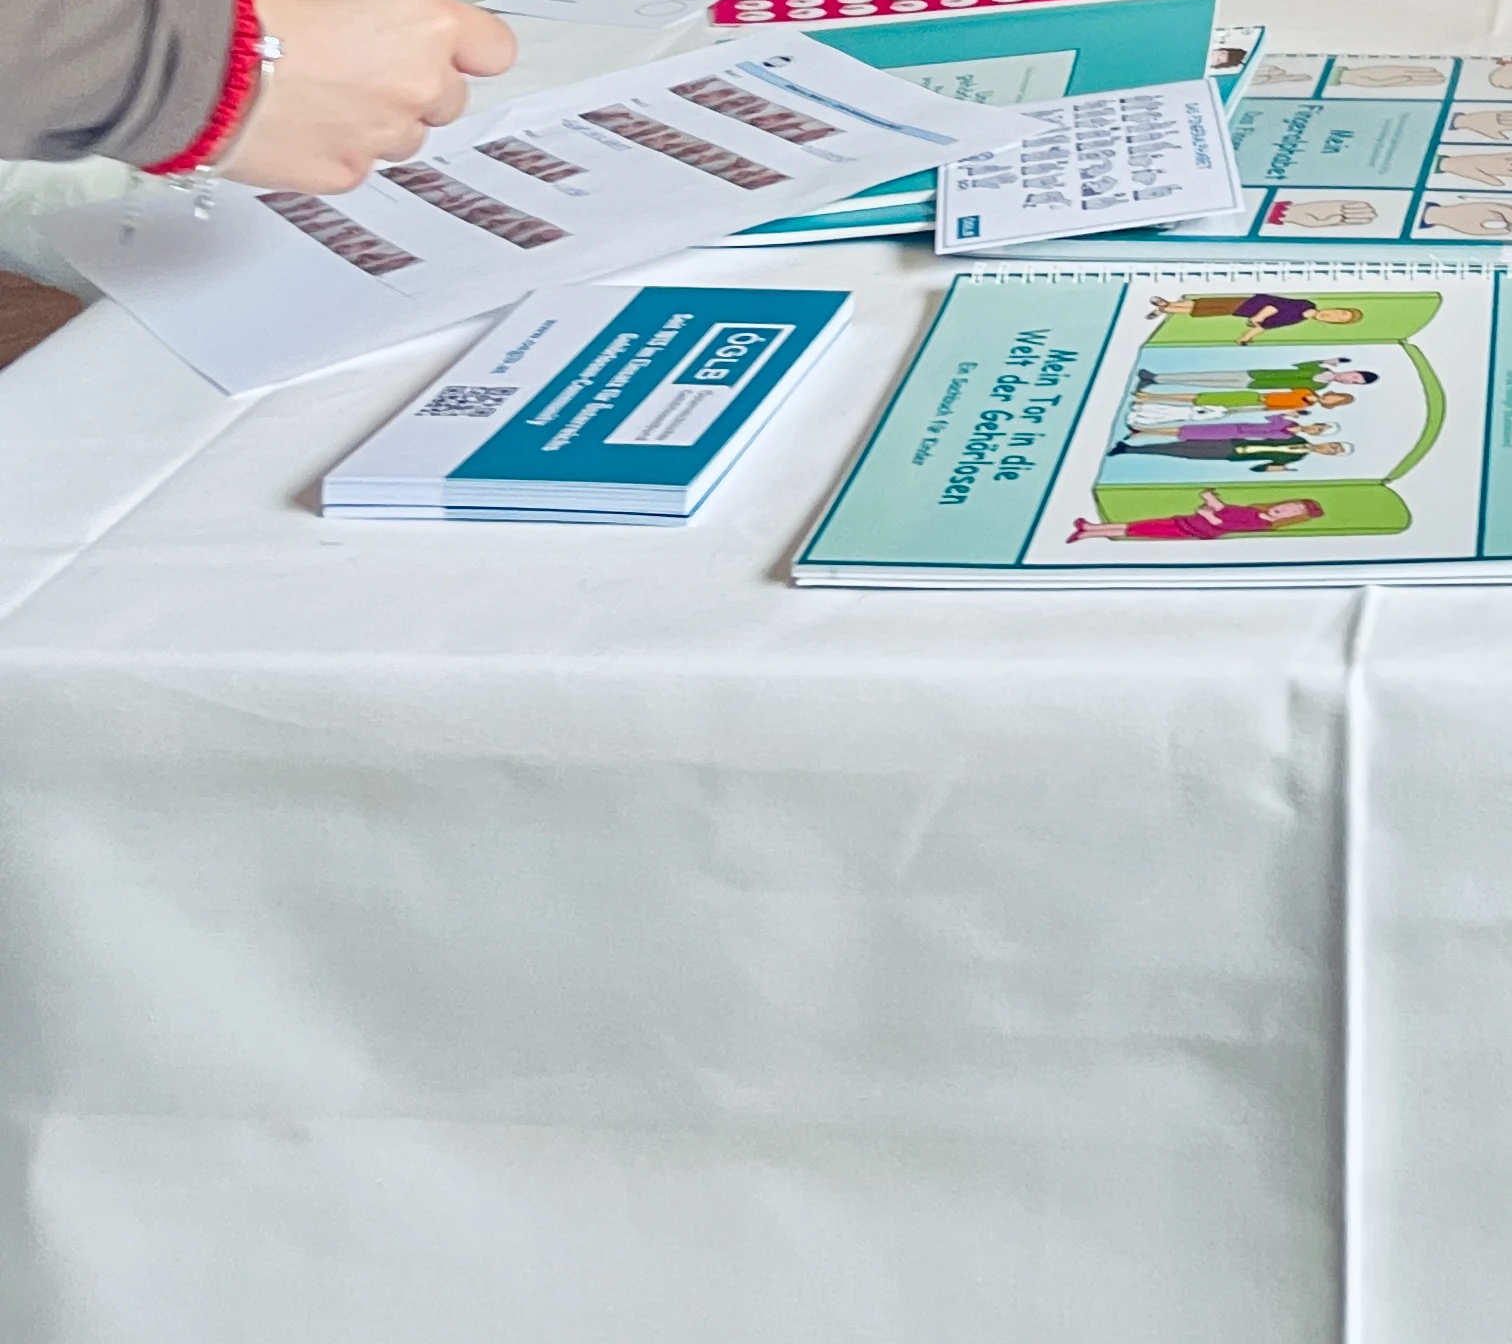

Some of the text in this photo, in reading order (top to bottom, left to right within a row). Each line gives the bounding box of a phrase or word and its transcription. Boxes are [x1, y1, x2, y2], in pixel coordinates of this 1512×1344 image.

[1265, 104, 1324, 180] Fingeralphabet
[1321, 129, 1354, 153] Mein
[938, 329, 1051, 505] Welt der Gehörlosen
[993, 349, 1079, 481] Mein Tor in die
